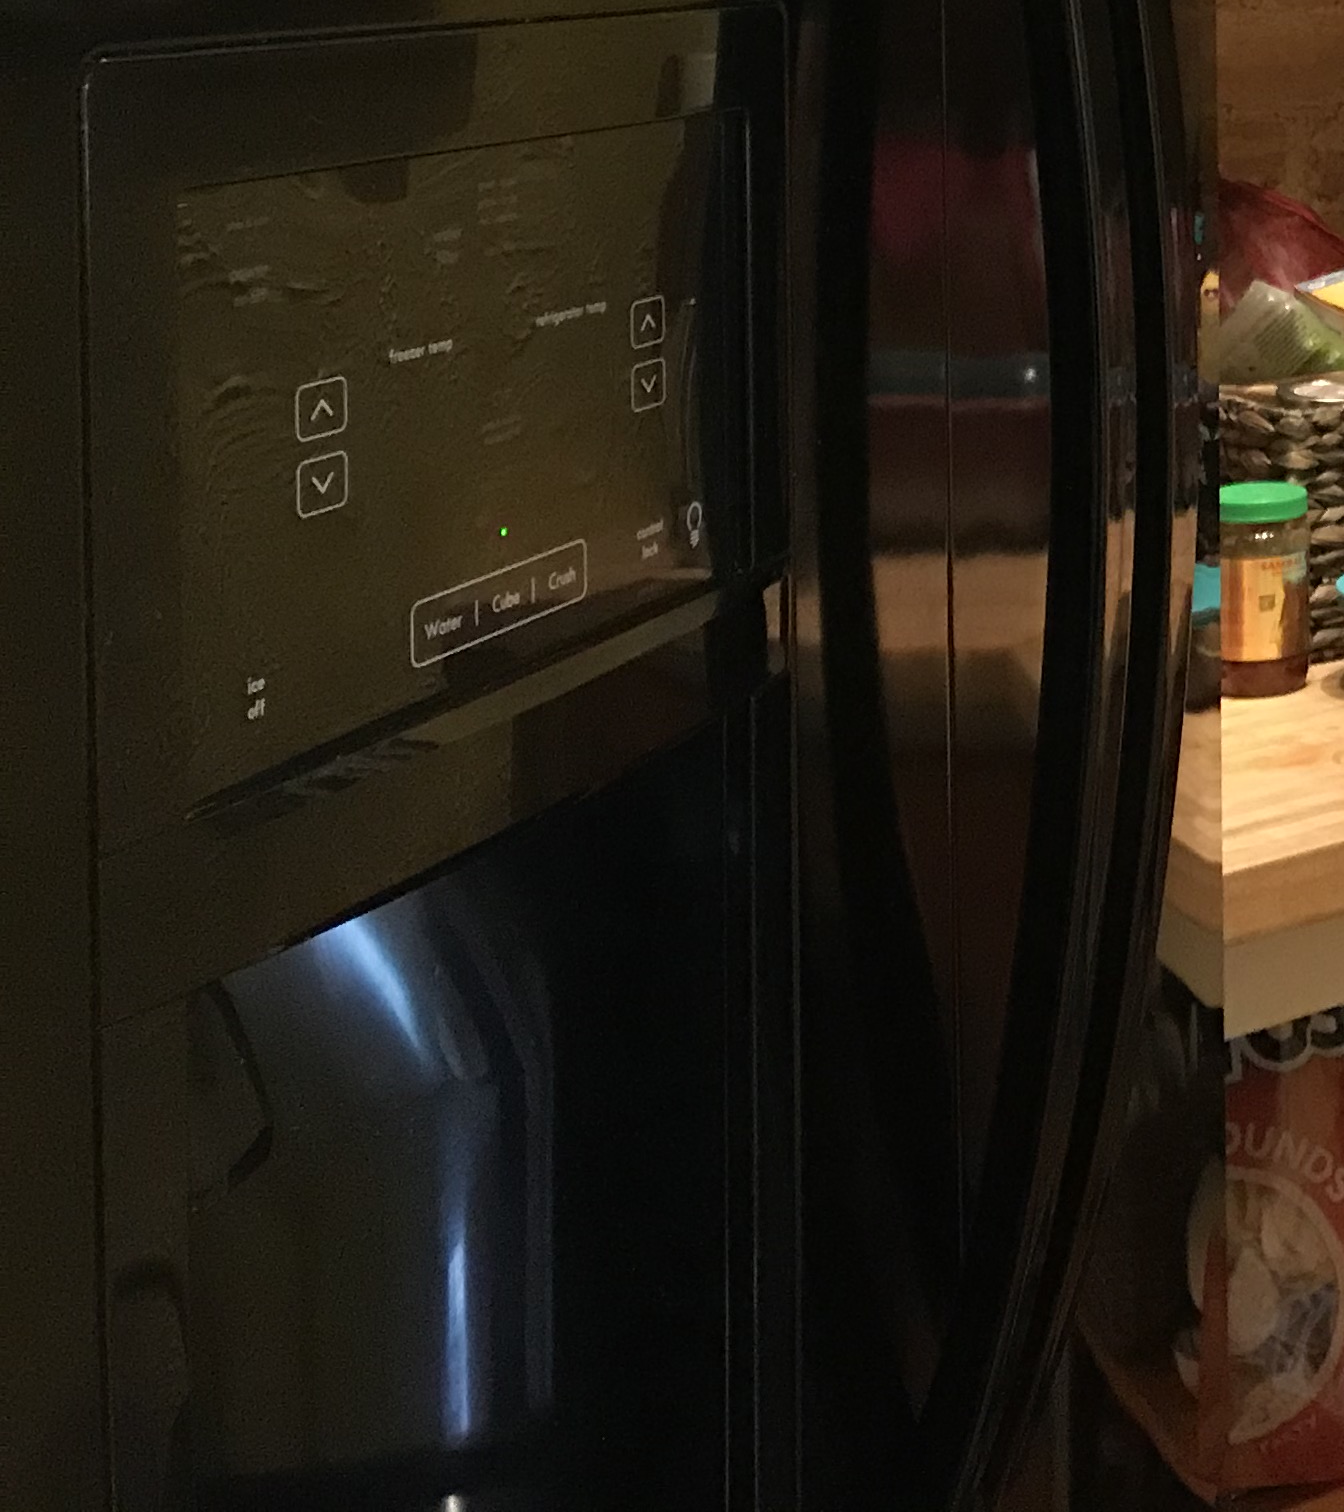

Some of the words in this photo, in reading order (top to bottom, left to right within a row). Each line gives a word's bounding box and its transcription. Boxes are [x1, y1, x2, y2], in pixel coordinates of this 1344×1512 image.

[388, 346, 425, 364] freezer
[428, 339, 453, 356] temp
[424, 612, 463, 641] Water
[491, 589, 521, 614] Cube
[548, 566, 578, 591] Crush
[246, 698, 266, 721] off
